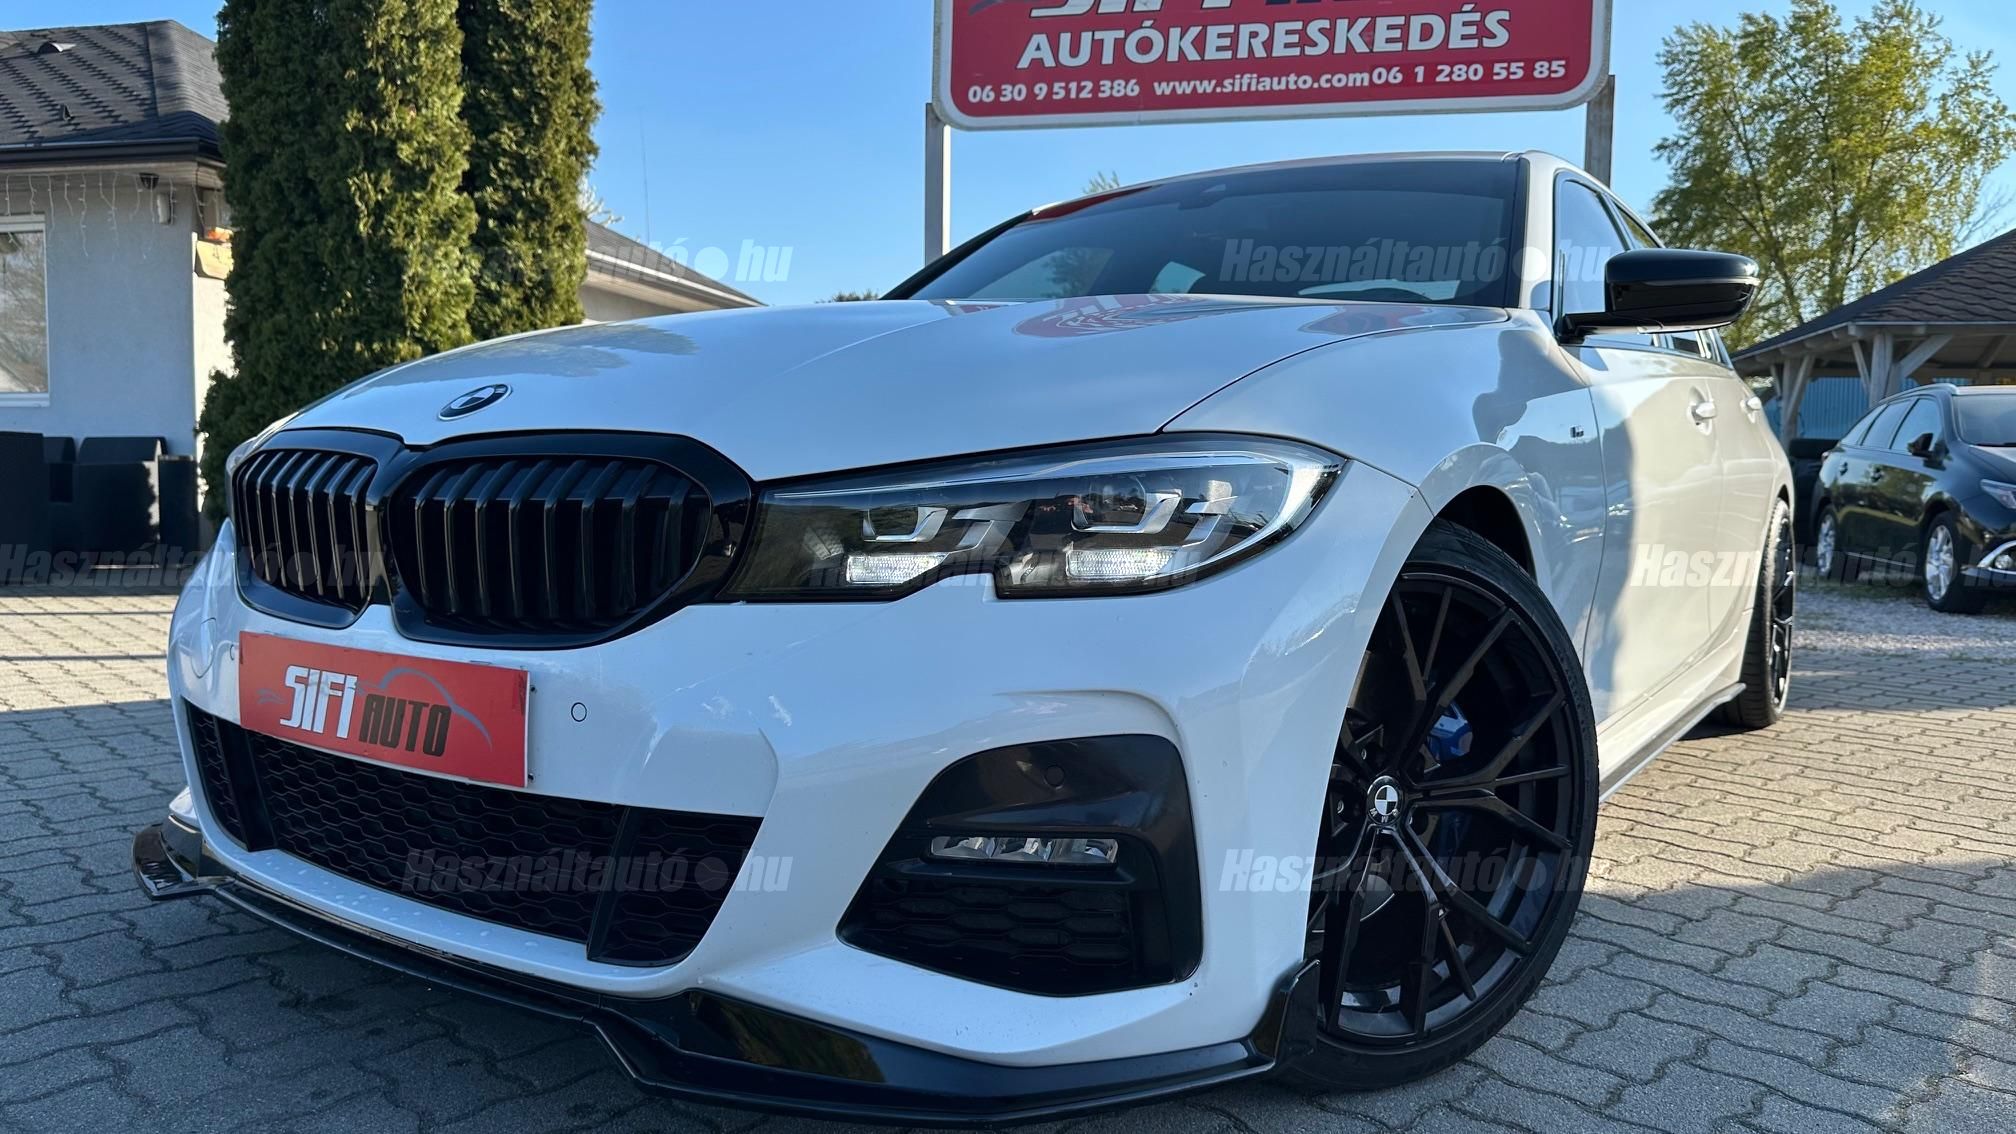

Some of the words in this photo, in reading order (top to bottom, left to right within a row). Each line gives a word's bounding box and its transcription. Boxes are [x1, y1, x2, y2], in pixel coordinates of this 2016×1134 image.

[1016, 3, 1511, 69] AUTÓKERESKEDÉS
[968, 85, 995, 102] 06
[1000, 84, 1027, 101] 30
[1034, 83, 1048, 100] 9
[1052, 81, 1093, 99] 512
[1098, 79, 1140, 97] 386
[1153, 70, 1369, 96] www.sifiauto.com
[1372, 66, 1403, 84] 06
[1414, 66, 1425, 83] 1
[1435, 63, 1484, 82] 280
[1492, 62, 1525, 80] 55
[1533, 60, 1566, 78] 85
[358, 693, 452, 757] AUTO
